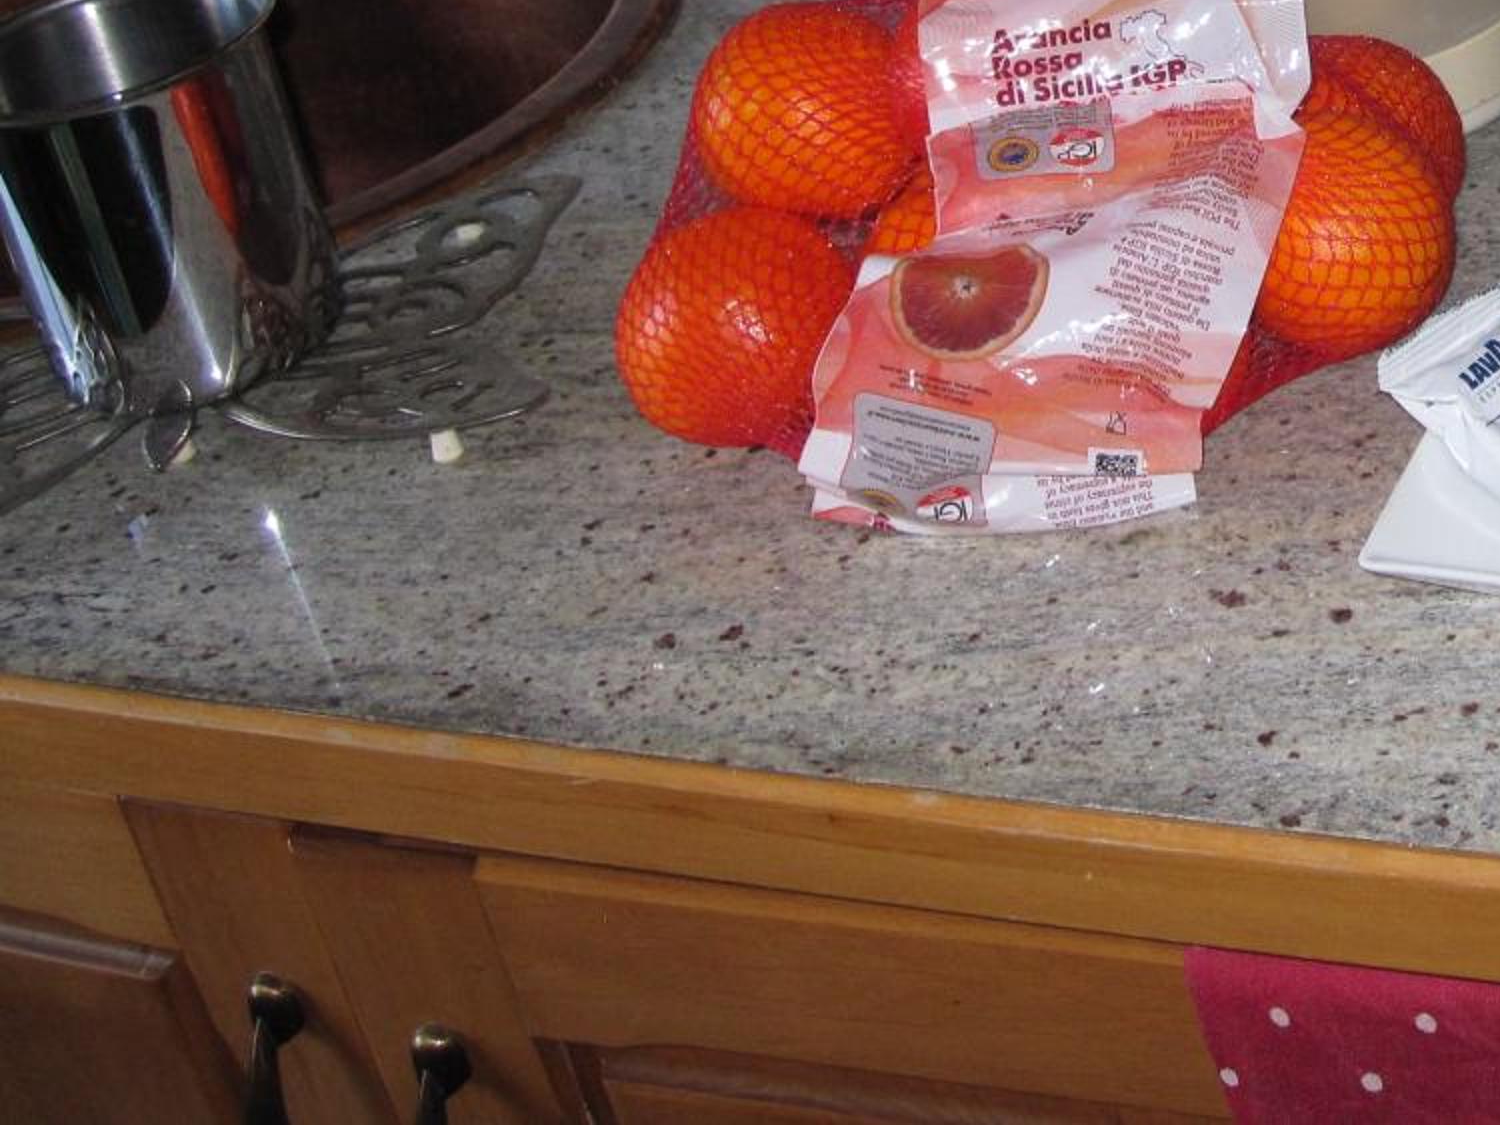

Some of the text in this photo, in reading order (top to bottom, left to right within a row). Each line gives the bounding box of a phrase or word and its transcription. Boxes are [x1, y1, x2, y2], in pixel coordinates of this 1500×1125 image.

[992, 51, 1083, 81] Rossa
[996, 59, 1187, 106] di Sicilia IGP
[1222, 217, 1240, 231] The
[933, 499, 970, 523] IG
